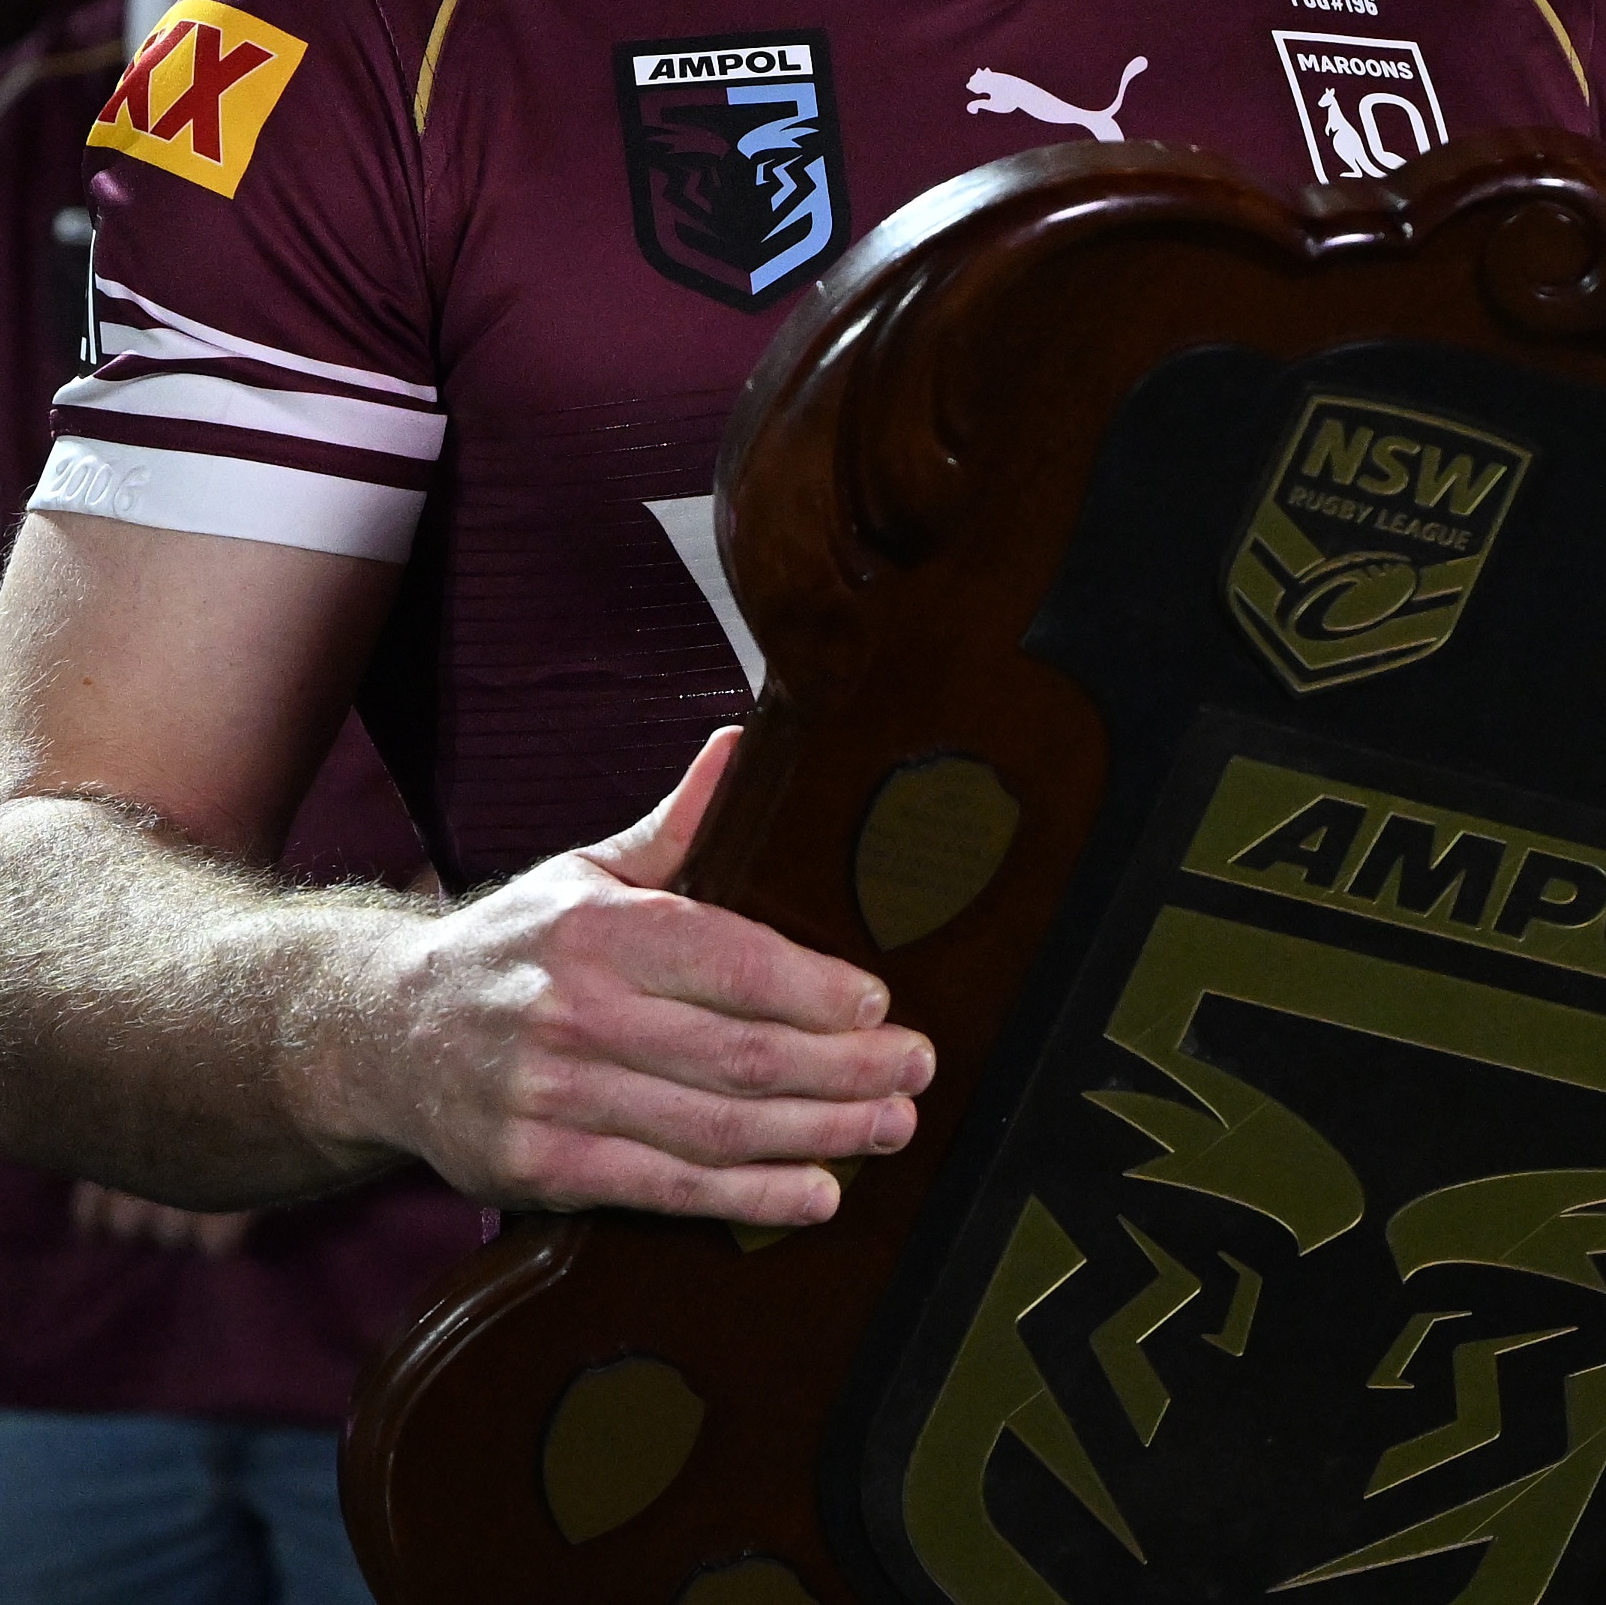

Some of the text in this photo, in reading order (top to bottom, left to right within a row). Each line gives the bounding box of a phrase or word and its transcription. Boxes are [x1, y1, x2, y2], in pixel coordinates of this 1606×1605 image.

[648, 50, 802, 81] AMPOL
[1296, 53, 1415, 81] MAROONS
[1301, 417, 1509, 516] NSW
[1287, 484, 1474, 552] RUGBY LEAGUE
